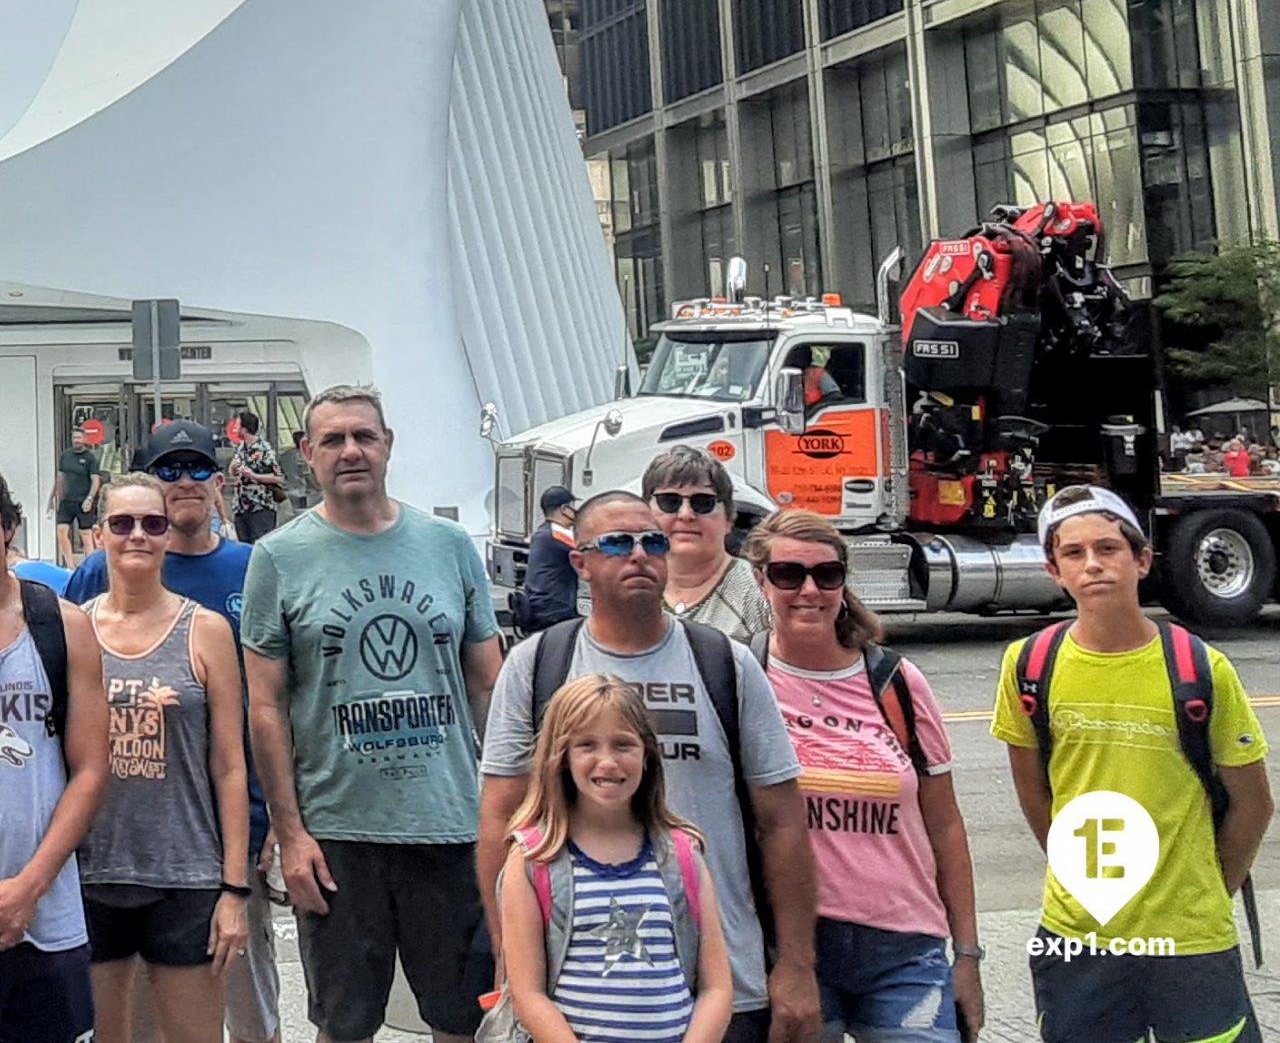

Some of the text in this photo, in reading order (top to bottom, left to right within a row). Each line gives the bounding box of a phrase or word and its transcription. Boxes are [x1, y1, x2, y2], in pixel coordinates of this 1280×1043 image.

[917, 344, 954, 355] FASSI
[802, 438, 841, 450] YORK
[322, 574, 450, 658] VOLKSWAGEN
[332, 694, 456, 736] TRANSPORTER
[823, 715, 864, 733] ON
[109, 738, 165, 760] ALOON
[346, 734, 445, 753] WOLFSBURG
[806, 797, 901, 835] NSHINE
